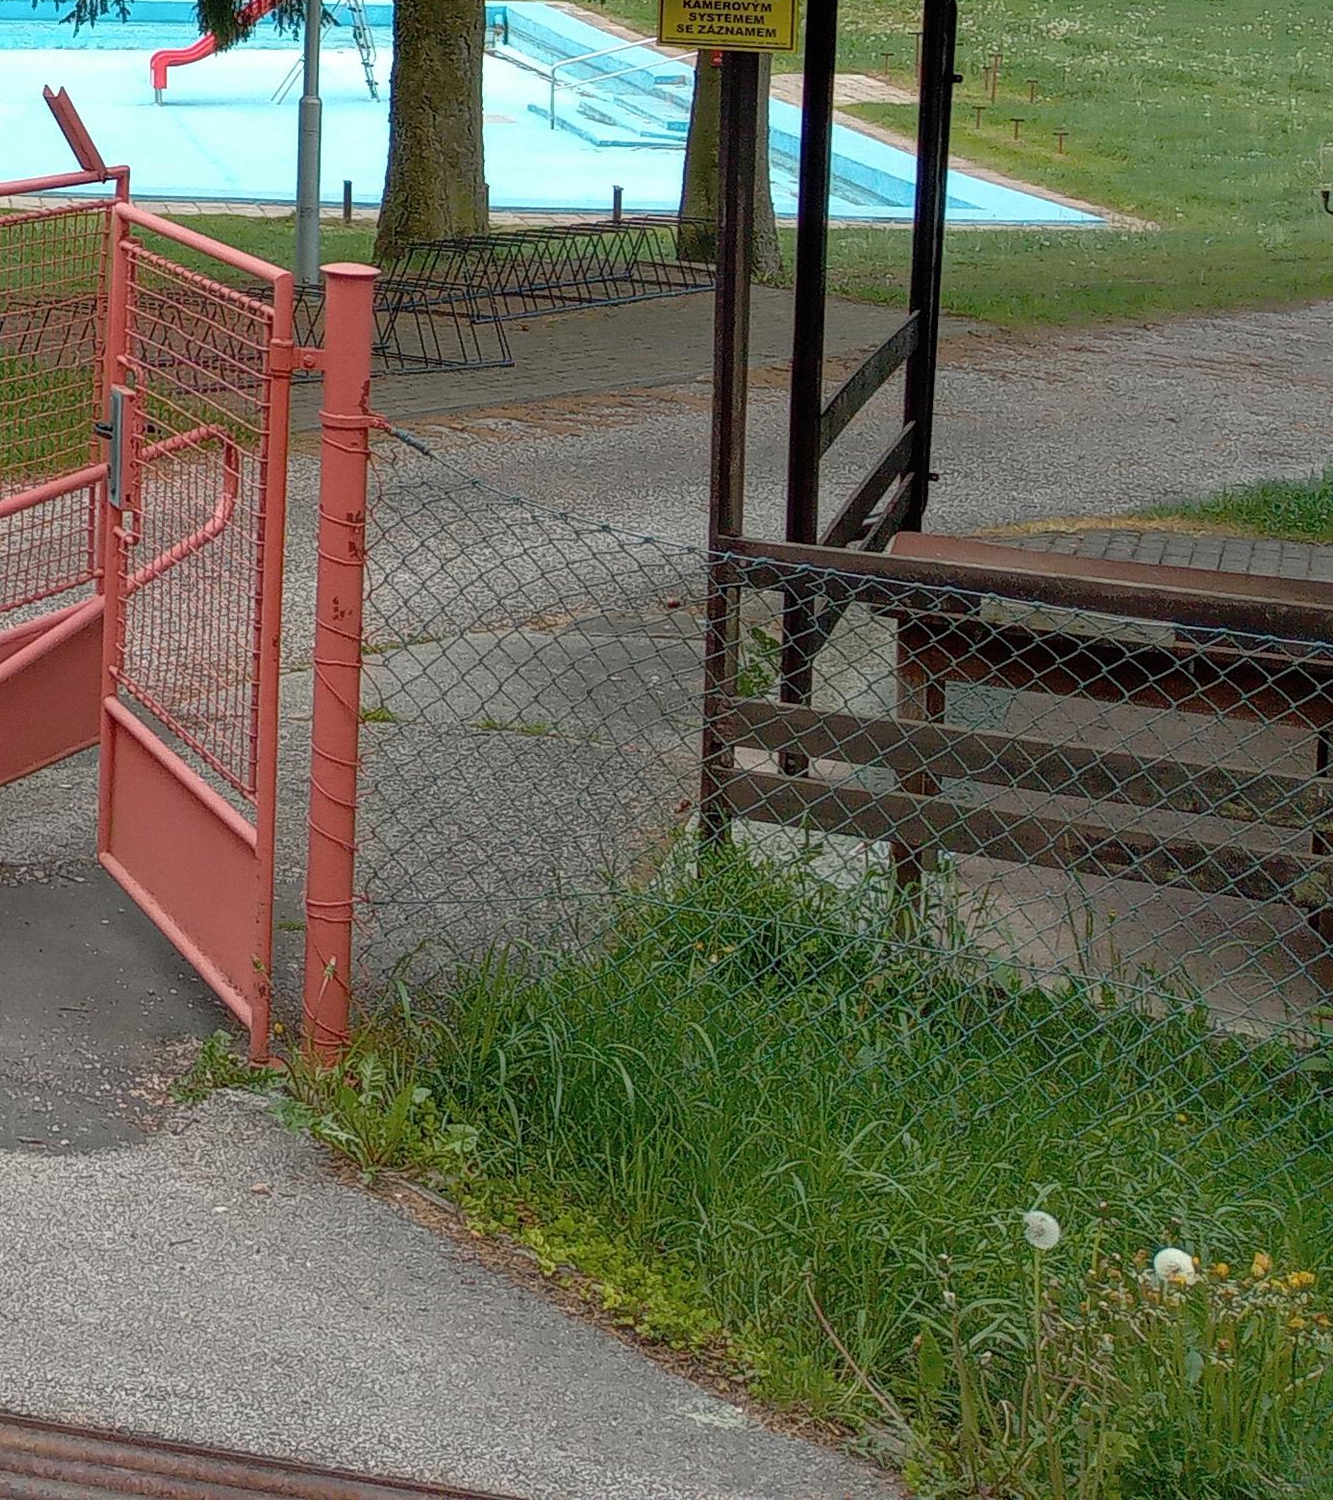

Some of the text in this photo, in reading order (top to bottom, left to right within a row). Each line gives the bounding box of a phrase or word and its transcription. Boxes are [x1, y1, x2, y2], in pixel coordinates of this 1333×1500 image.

[682, 0, 773, 13] KAMEROVÝM
[676, 23, 777, 38] SE ZÁZNAMEM
